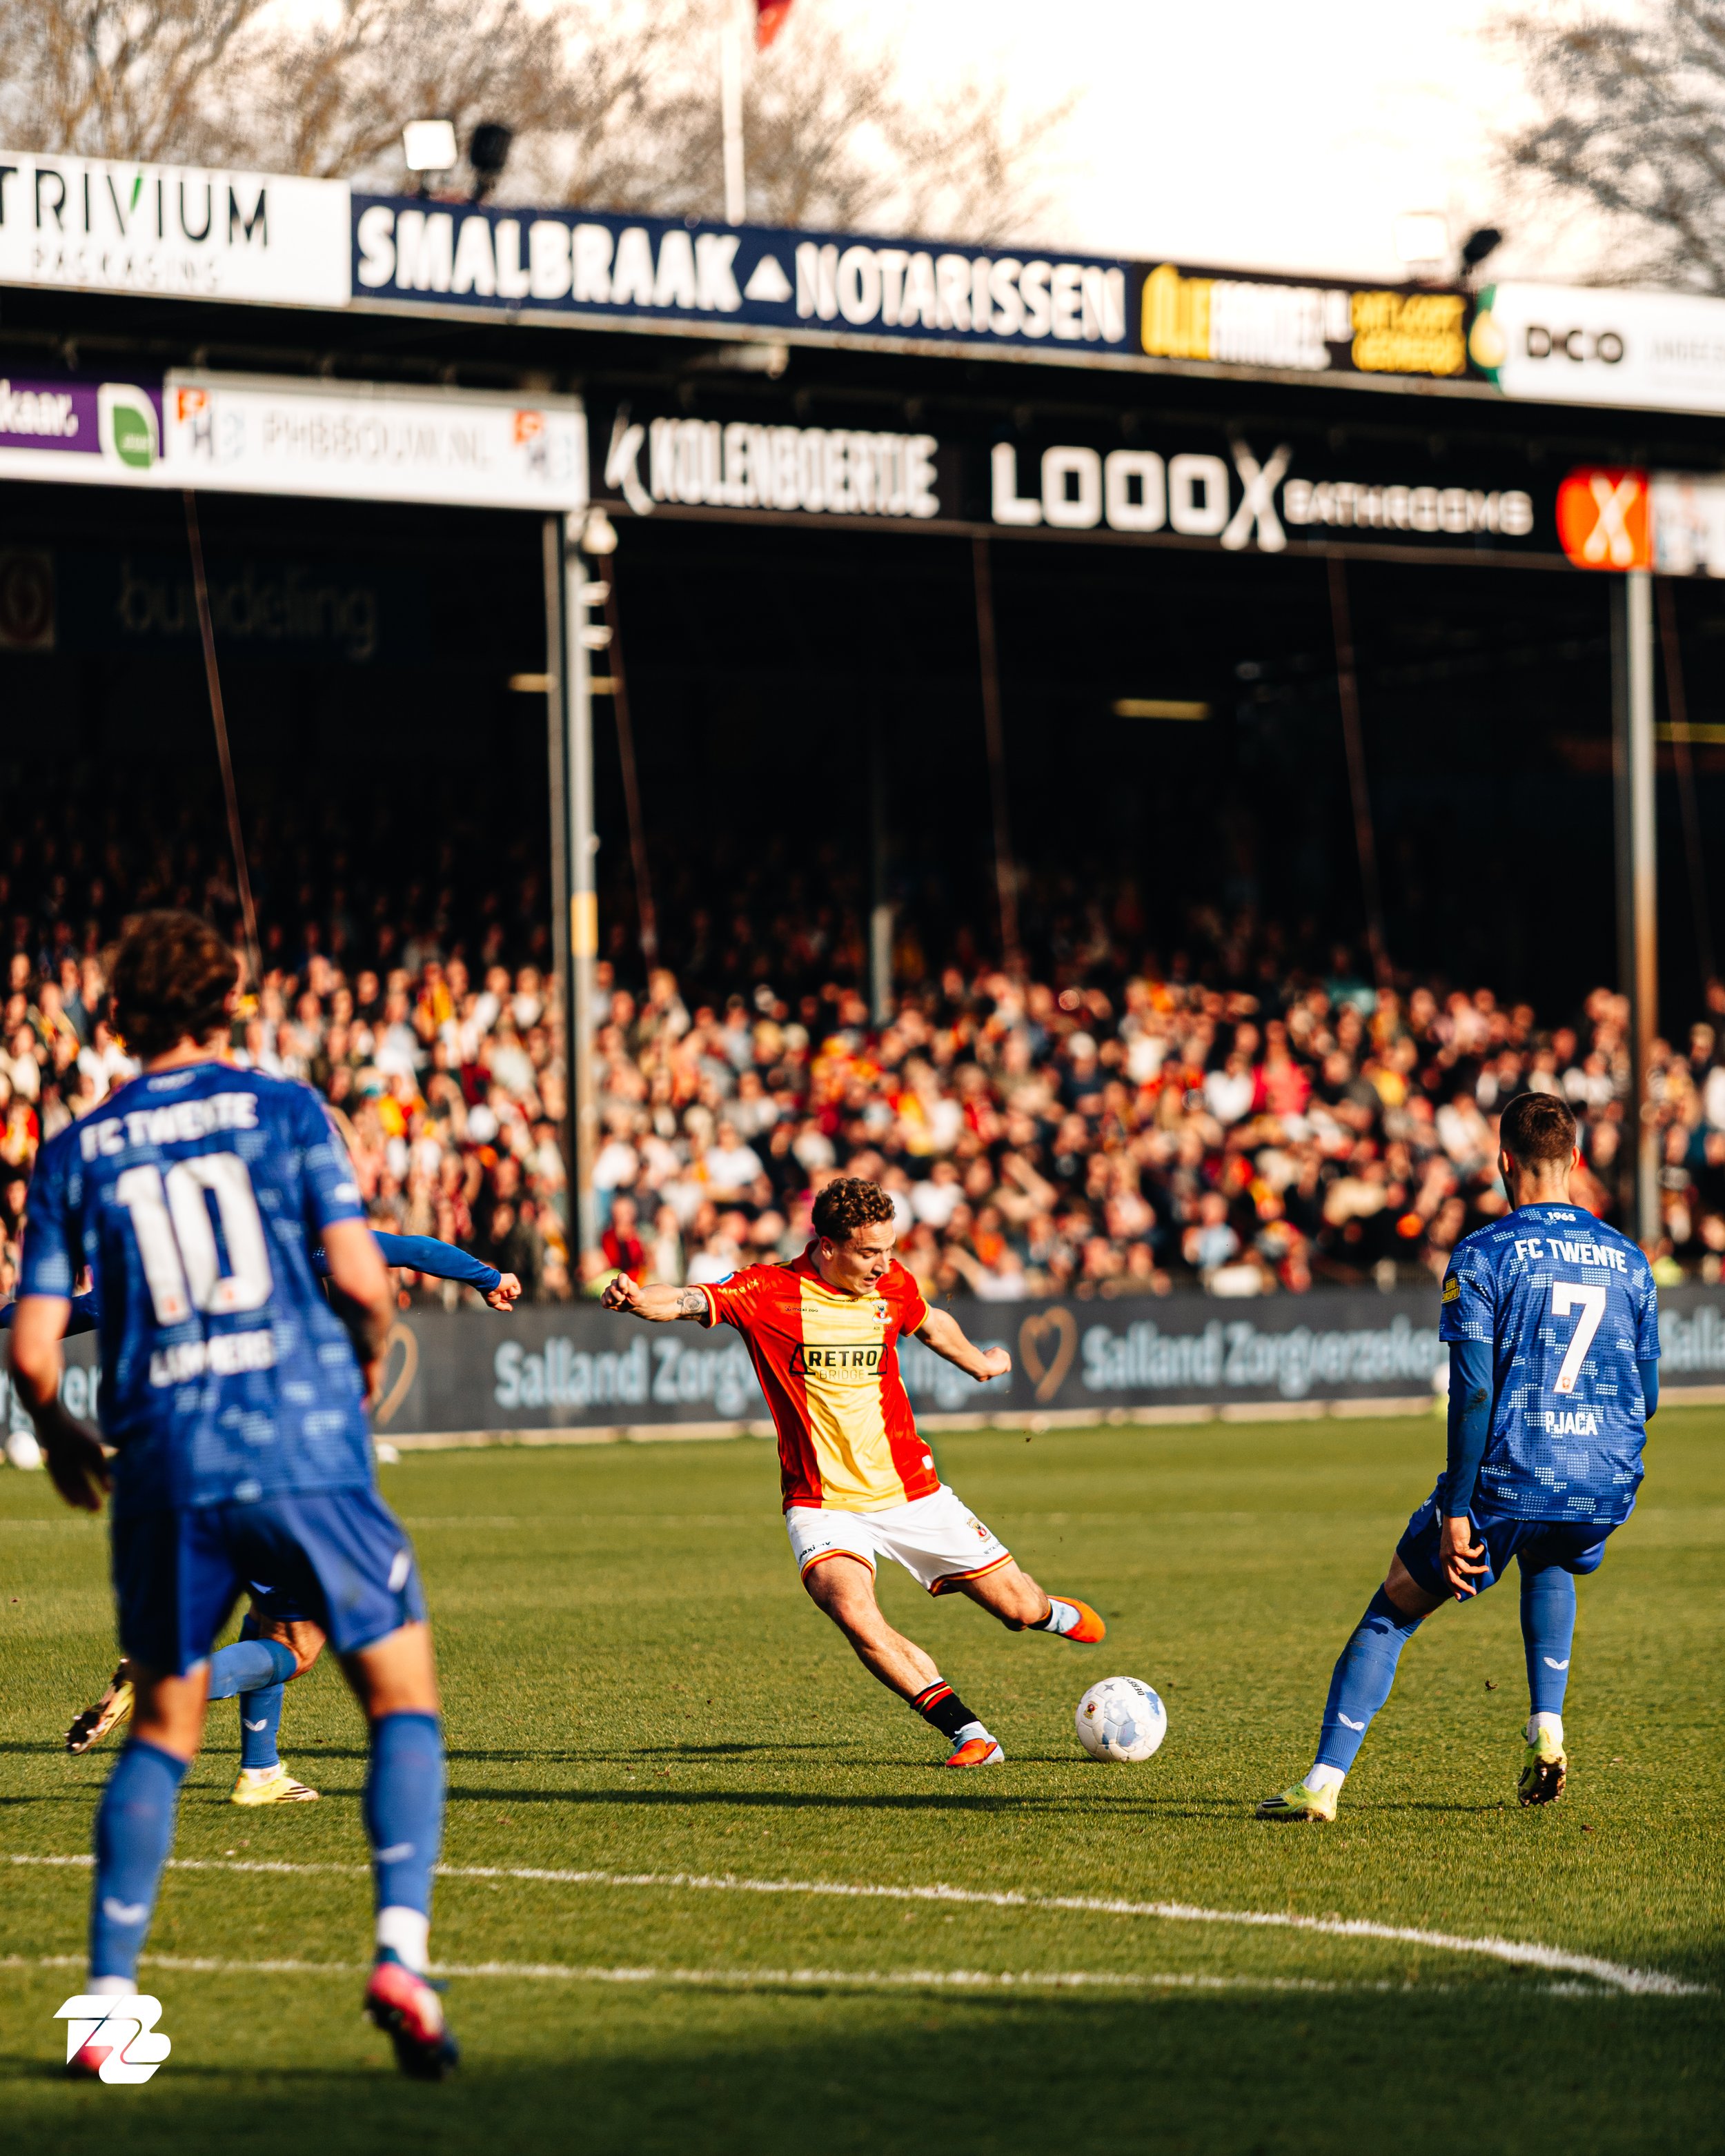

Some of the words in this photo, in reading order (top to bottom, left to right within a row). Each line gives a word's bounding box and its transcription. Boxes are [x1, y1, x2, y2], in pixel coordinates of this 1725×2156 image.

[357, 205, 742, 313] SMALBRAAK
[795, 241, 1127, 344] NOTARISSEN
[115, 1151, 275, 1327] 10
[1547, 1211, 1576, 1222] 1965
[1515, 1238, 1544, 1261] FC
[1546, 1238, 1628, 1274] TWENTE
[809, 1349, 878, 1367] RETRO
[1082, 1318, 1223, 1392] Salland
[1552, 1281, 1606, 1394] 7
[493, 1334, 650, 1410] Salland
[819, 1369, 865, 1381] BRIDGE
[1545, 1412, 1598, 1436] PJACA
